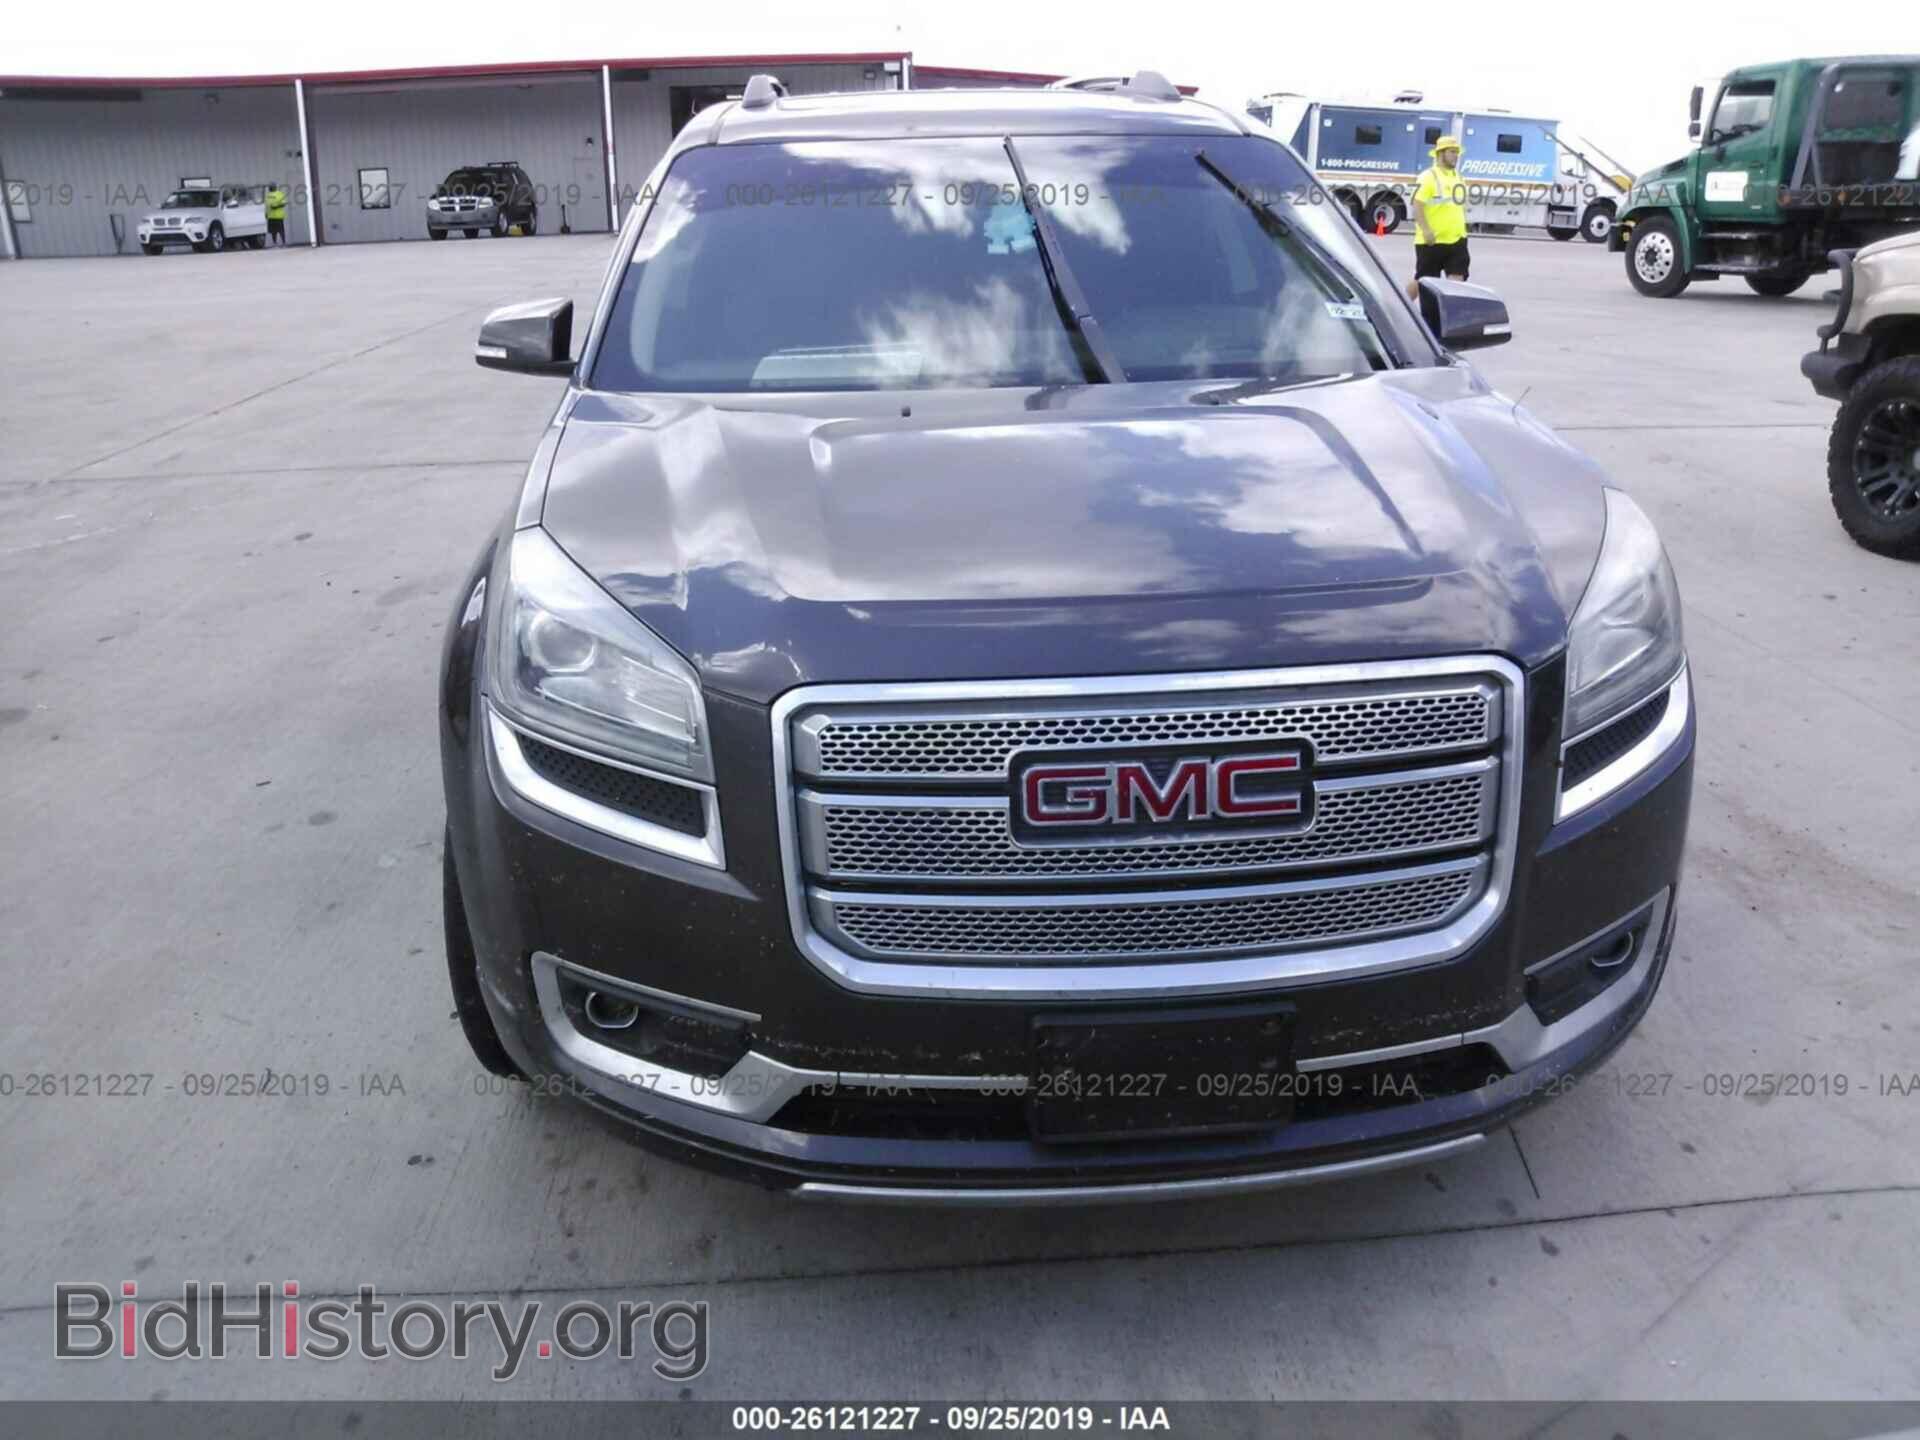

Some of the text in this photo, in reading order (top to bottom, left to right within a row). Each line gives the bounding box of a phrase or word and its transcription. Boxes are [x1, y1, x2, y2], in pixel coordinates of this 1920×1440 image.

[1321, 159, 1399, 170] 1-800-PROGRESSIVE
[1461, 160, 1548, 177] PROGRESSIVE
[1022, 752, 1301, 826] GMC
